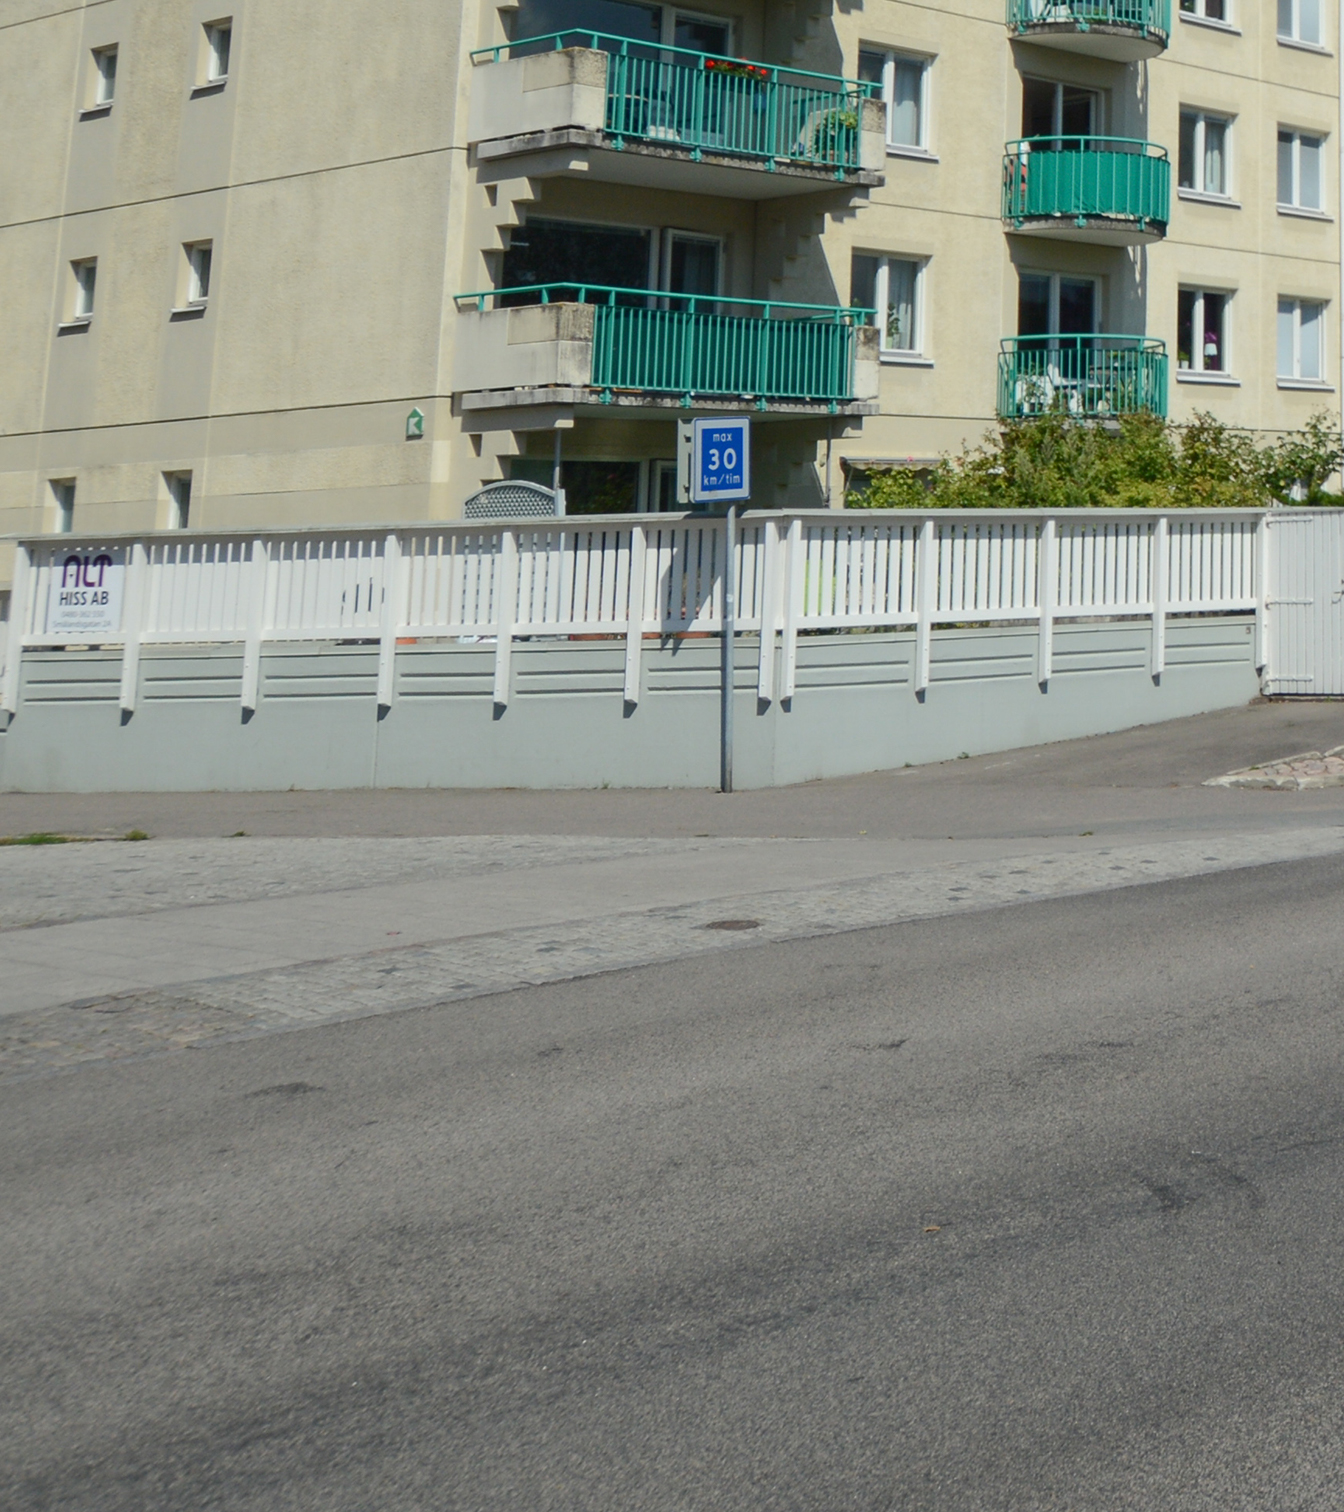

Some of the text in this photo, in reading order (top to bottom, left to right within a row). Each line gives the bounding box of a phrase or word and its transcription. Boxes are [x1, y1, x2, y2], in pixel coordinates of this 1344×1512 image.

[712, 433, 733, 442] max
[708, 448, 737, 471] 30
[703, 473, 741, 486] km/tim
[59, 591, 109, 606] HISS AB
